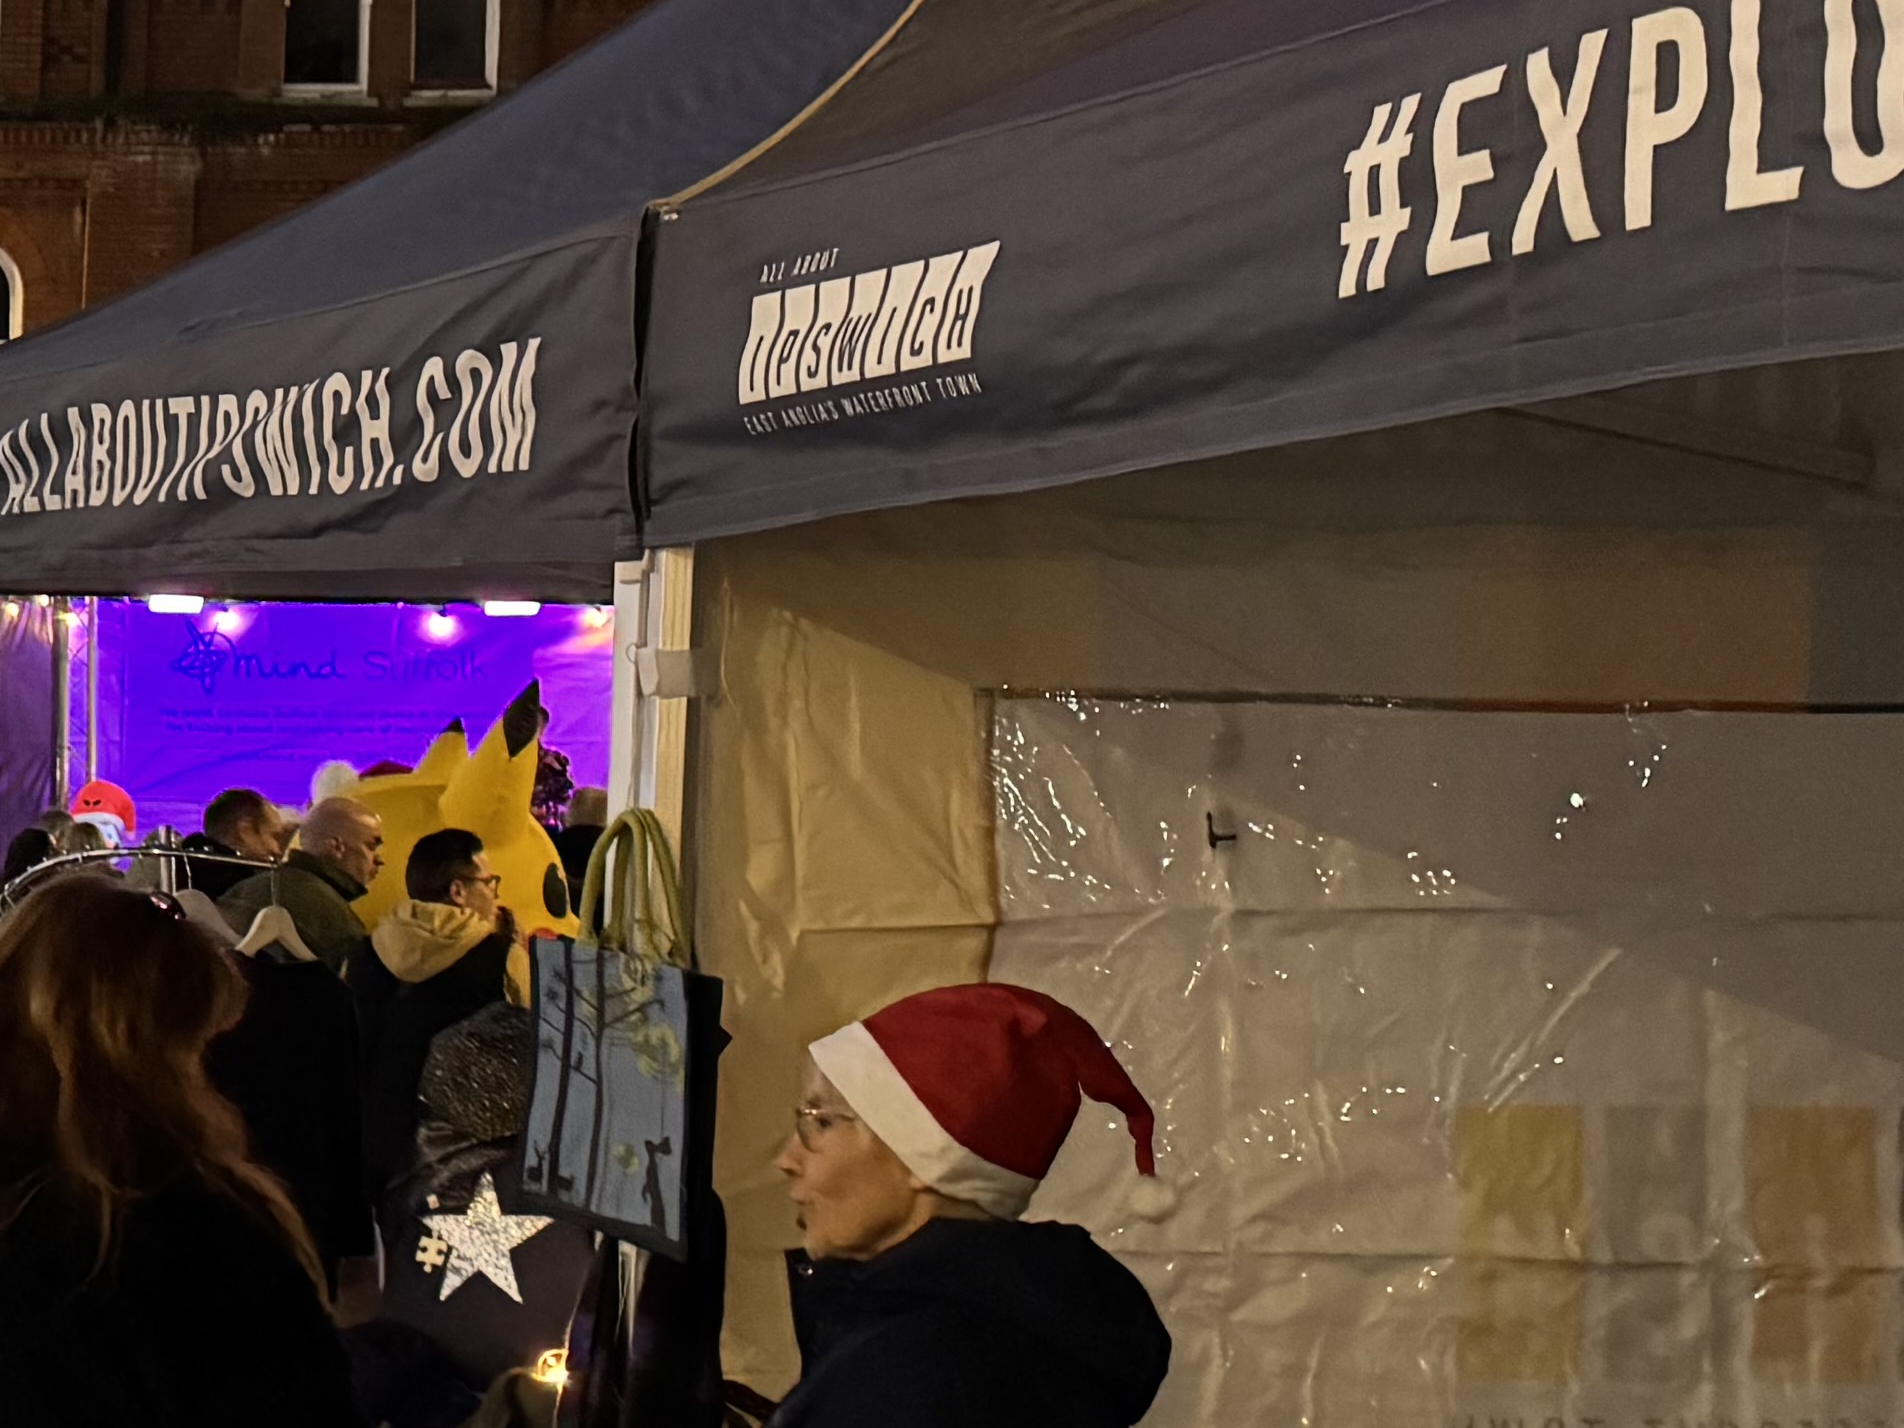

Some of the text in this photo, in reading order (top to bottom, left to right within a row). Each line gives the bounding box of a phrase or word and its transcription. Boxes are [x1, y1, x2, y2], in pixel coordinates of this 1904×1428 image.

[759, 248, 840, 284] ALL ABOUT
[746, 274, 980, 396] IPSWICH
[744, 373, 983, 435] EAST ANGLIA'S WATERFRONT TOWN
